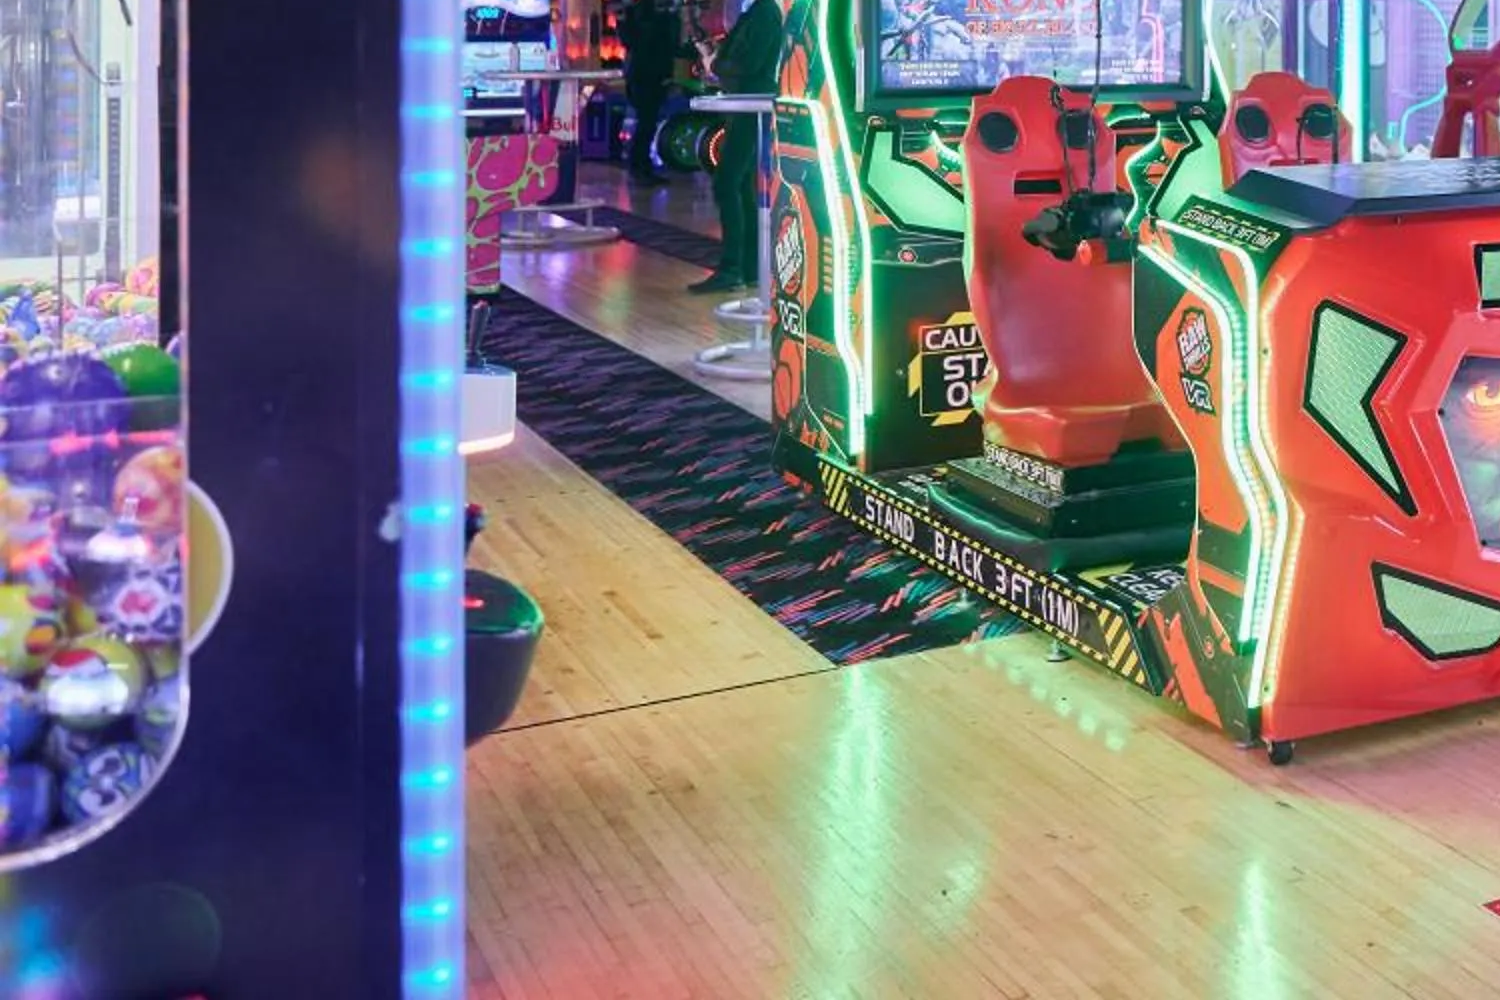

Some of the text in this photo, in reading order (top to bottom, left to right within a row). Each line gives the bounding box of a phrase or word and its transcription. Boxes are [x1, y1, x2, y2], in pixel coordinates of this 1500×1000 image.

[925, 327, 977, 350] CAU
[946, 381, 975, 407] O
[864, 496, 916, 543] STAND
[934, 531, 983, 583] BACK
[1041, 586, 1079, 637] (1M)
